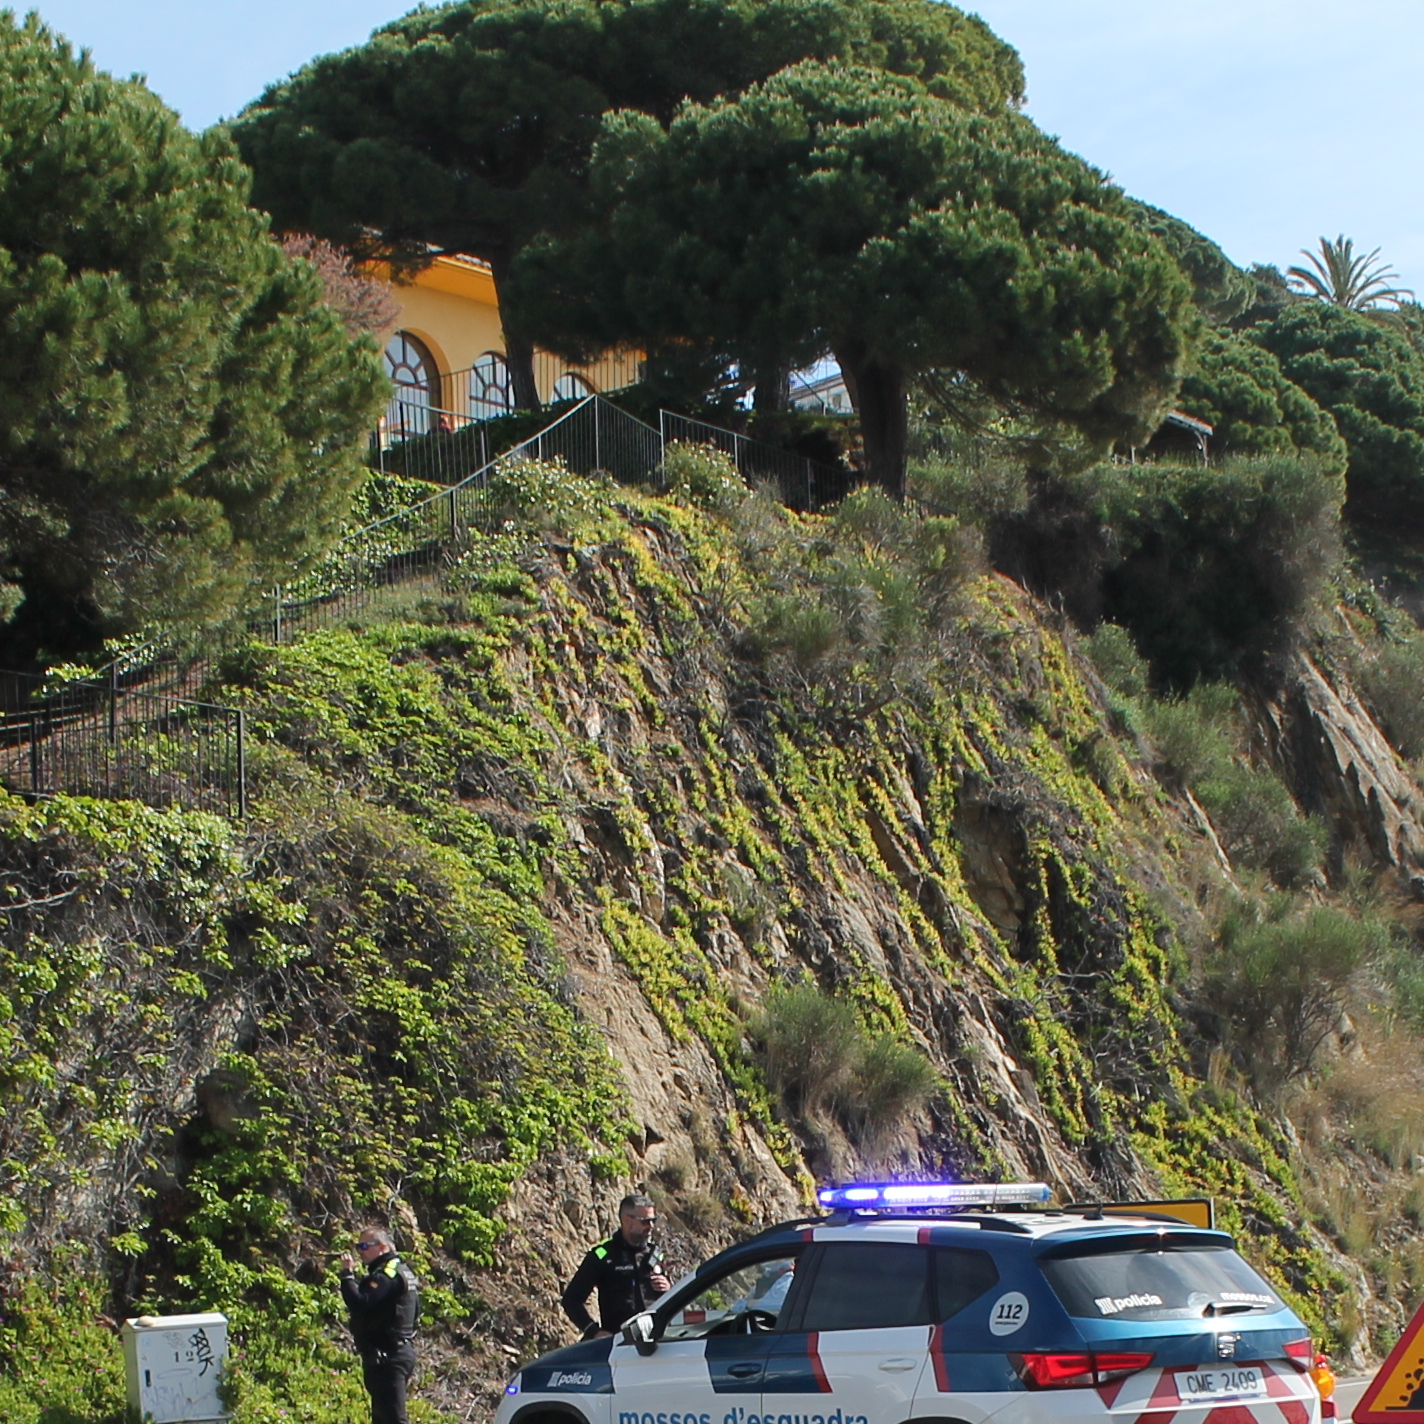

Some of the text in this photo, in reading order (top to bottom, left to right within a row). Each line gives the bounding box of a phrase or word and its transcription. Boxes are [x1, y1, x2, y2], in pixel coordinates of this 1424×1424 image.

[1116, 1293, 1163, 1312] policia
[996, 1304, 1023, 1319] 112
[557, 1371, 592, 1386] policia
[1186, 1370, 1259, 1394] CME 2409
